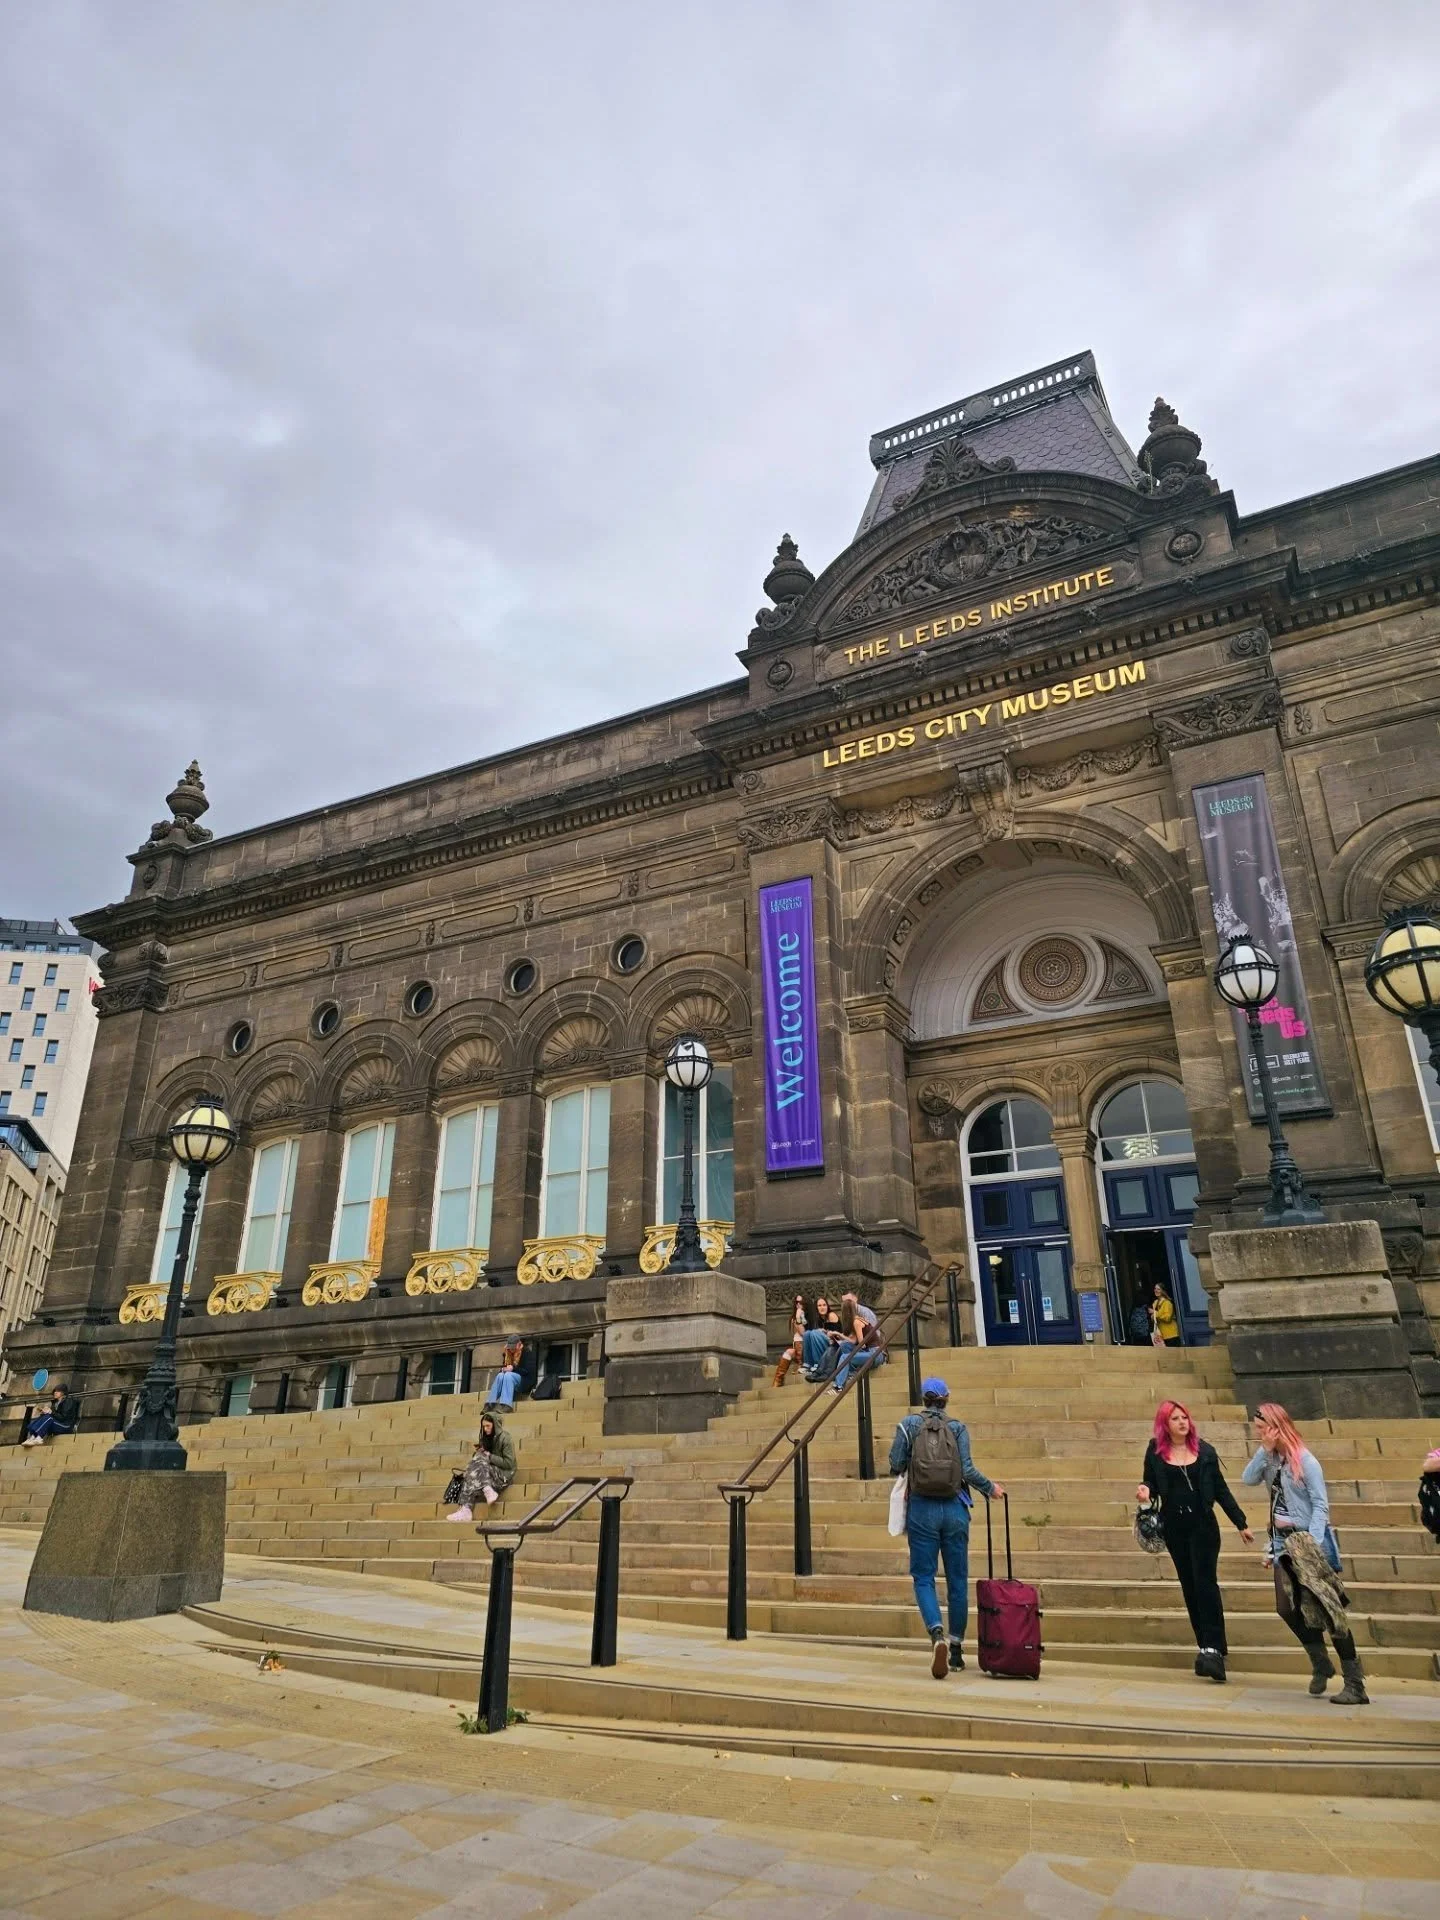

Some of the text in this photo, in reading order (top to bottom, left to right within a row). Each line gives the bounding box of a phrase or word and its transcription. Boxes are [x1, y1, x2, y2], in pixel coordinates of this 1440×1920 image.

[844, 567, 1114, 665] THE LEEDS INSTITUTE
[823, 660, 1146, 768] LEEDS CITY MUSEUM
[1209, 798, 1240, 810] LEEDS
[1210, 801, 1254, 817] MUSEUM
[771, 901, 802, 913] MUSEUM
[773, 931, 805, 1111] Welcome
